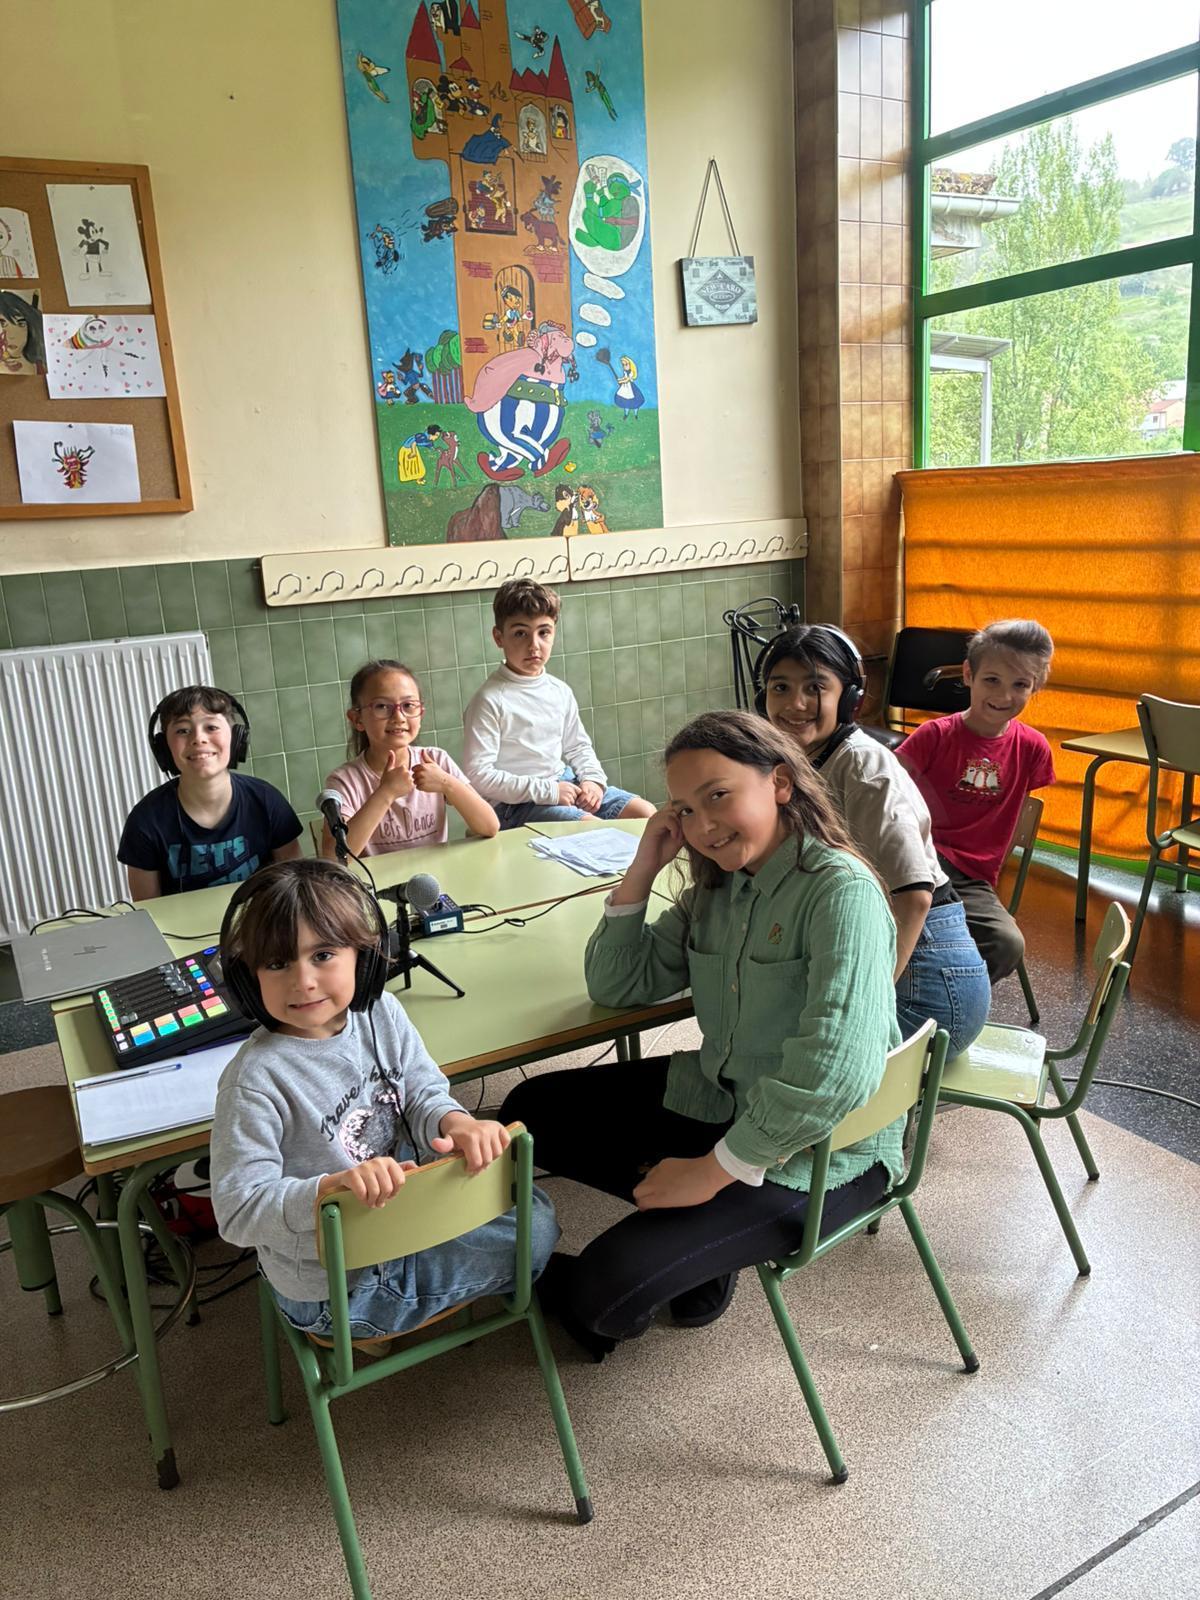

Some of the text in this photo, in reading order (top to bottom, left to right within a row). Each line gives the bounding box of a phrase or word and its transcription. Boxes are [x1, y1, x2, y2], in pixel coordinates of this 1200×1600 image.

[402, 806, 436, 839] Dance
[168, 836, 245, 880] LET'S
[320, 1085, 361, 1142] Trave
